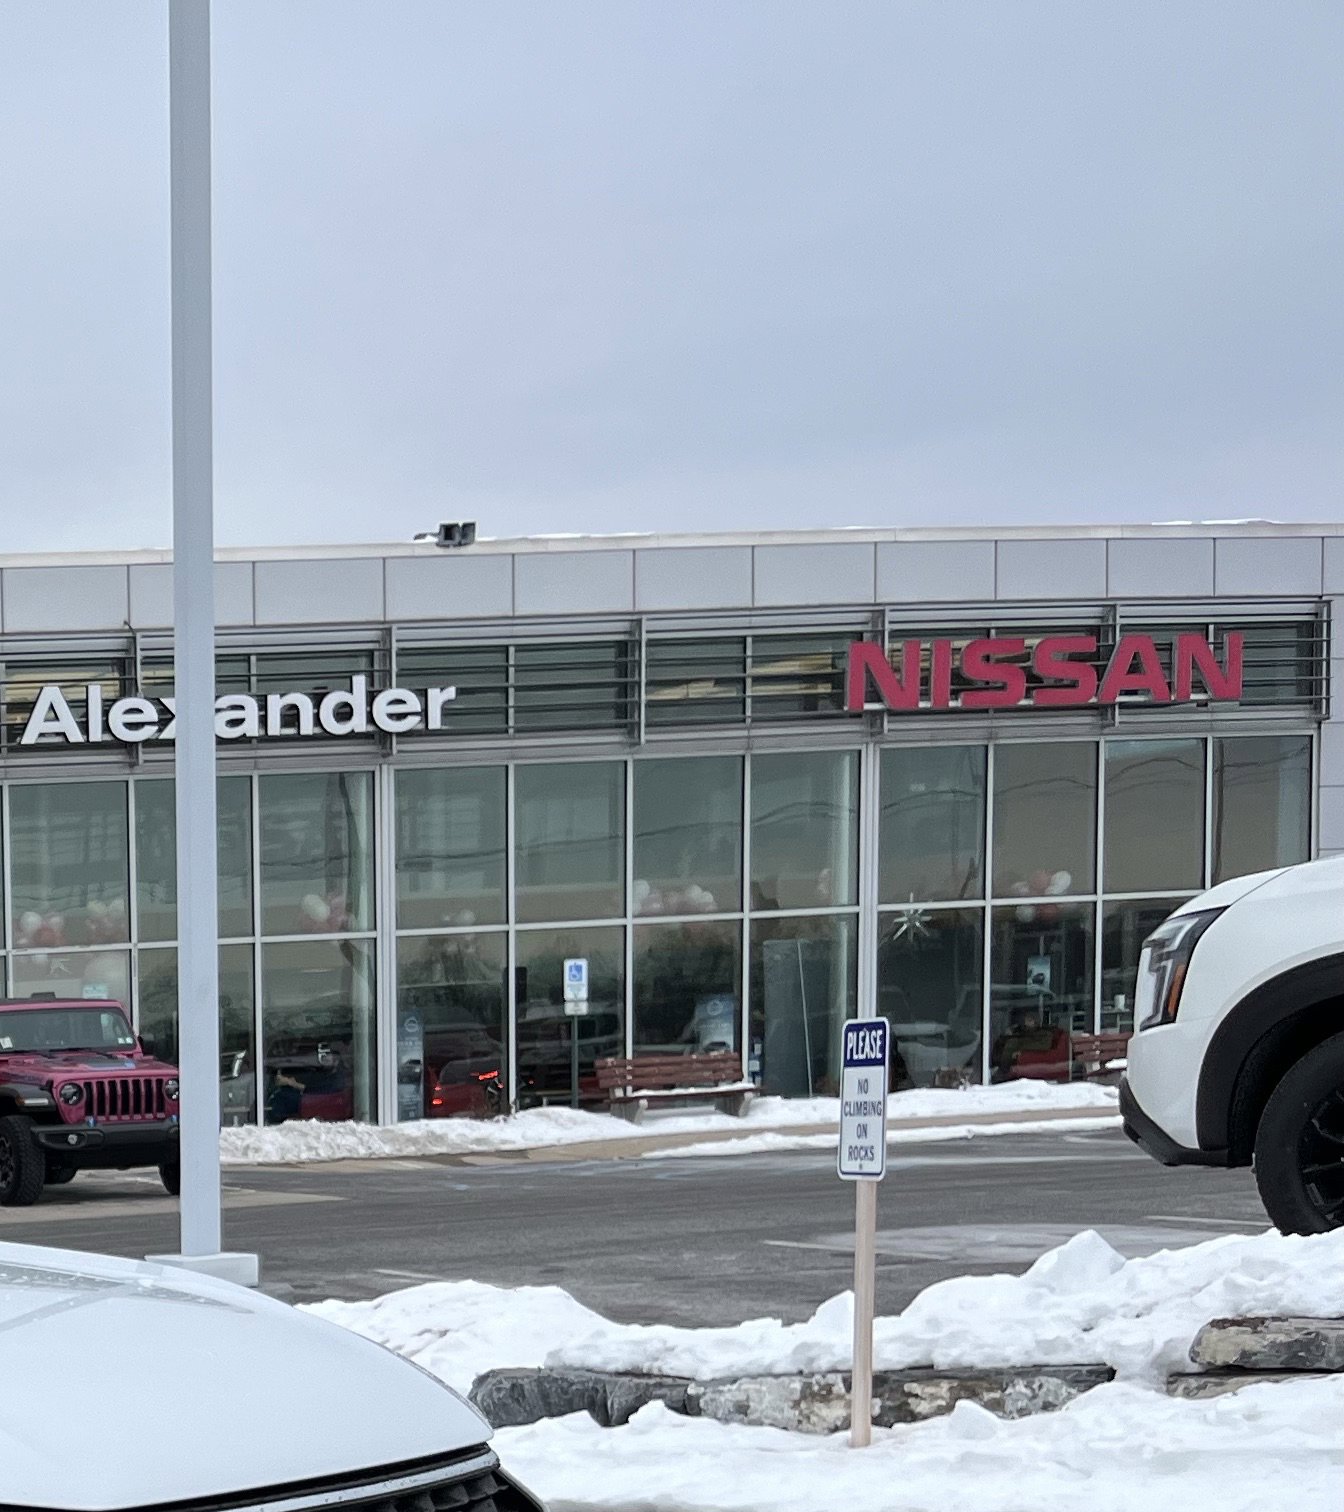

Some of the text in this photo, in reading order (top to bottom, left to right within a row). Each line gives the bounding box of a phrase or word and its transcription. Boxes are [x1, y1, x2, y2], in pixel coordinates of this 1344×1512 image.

[845, 632, 1244, 711] NISSAN
[846, 1029, 883, 1061] PLEASE
[857, 1078, 869, 1095] NO
[843, 1101, 882, 1118] CLIMBING
[856, 1123, 868, 1139] ON
[848, 1146, 875, 1162] ROCKS
